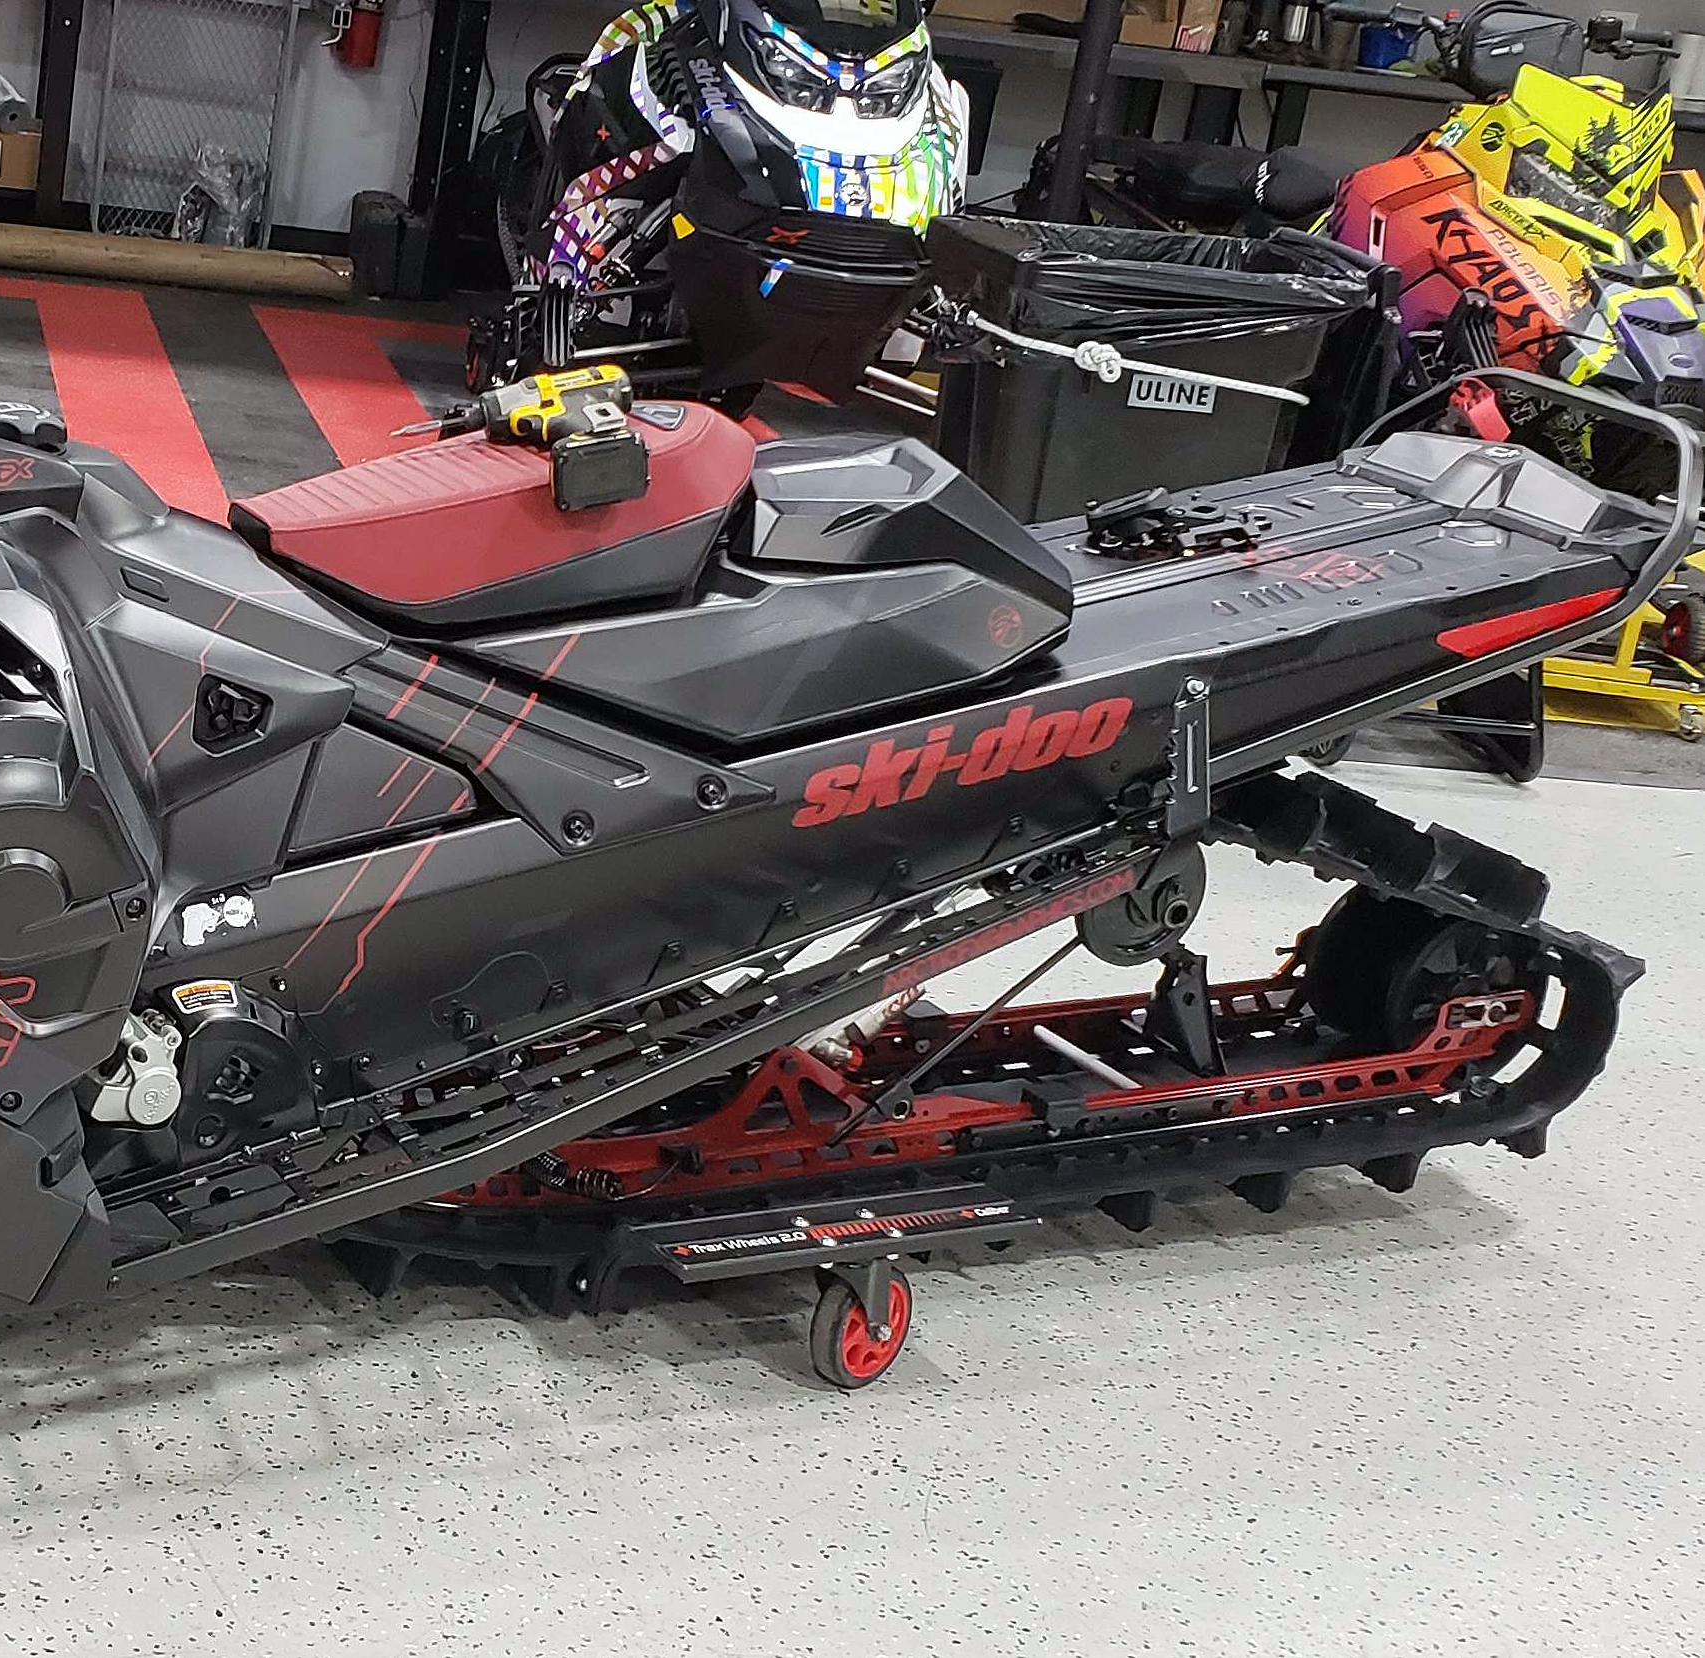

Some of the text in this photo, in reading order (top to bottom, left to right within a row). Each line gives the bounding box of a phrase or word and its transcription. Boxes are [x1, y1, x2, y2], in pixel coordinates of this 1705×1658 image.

[1486, 228, 1562, 306] POLARIS
[1136, 380, 1211, 406] ULINE
[791, 697, 1134, 828] ski-doo
[689, 1231, 808, 1254] Trax Wheels 2.0
